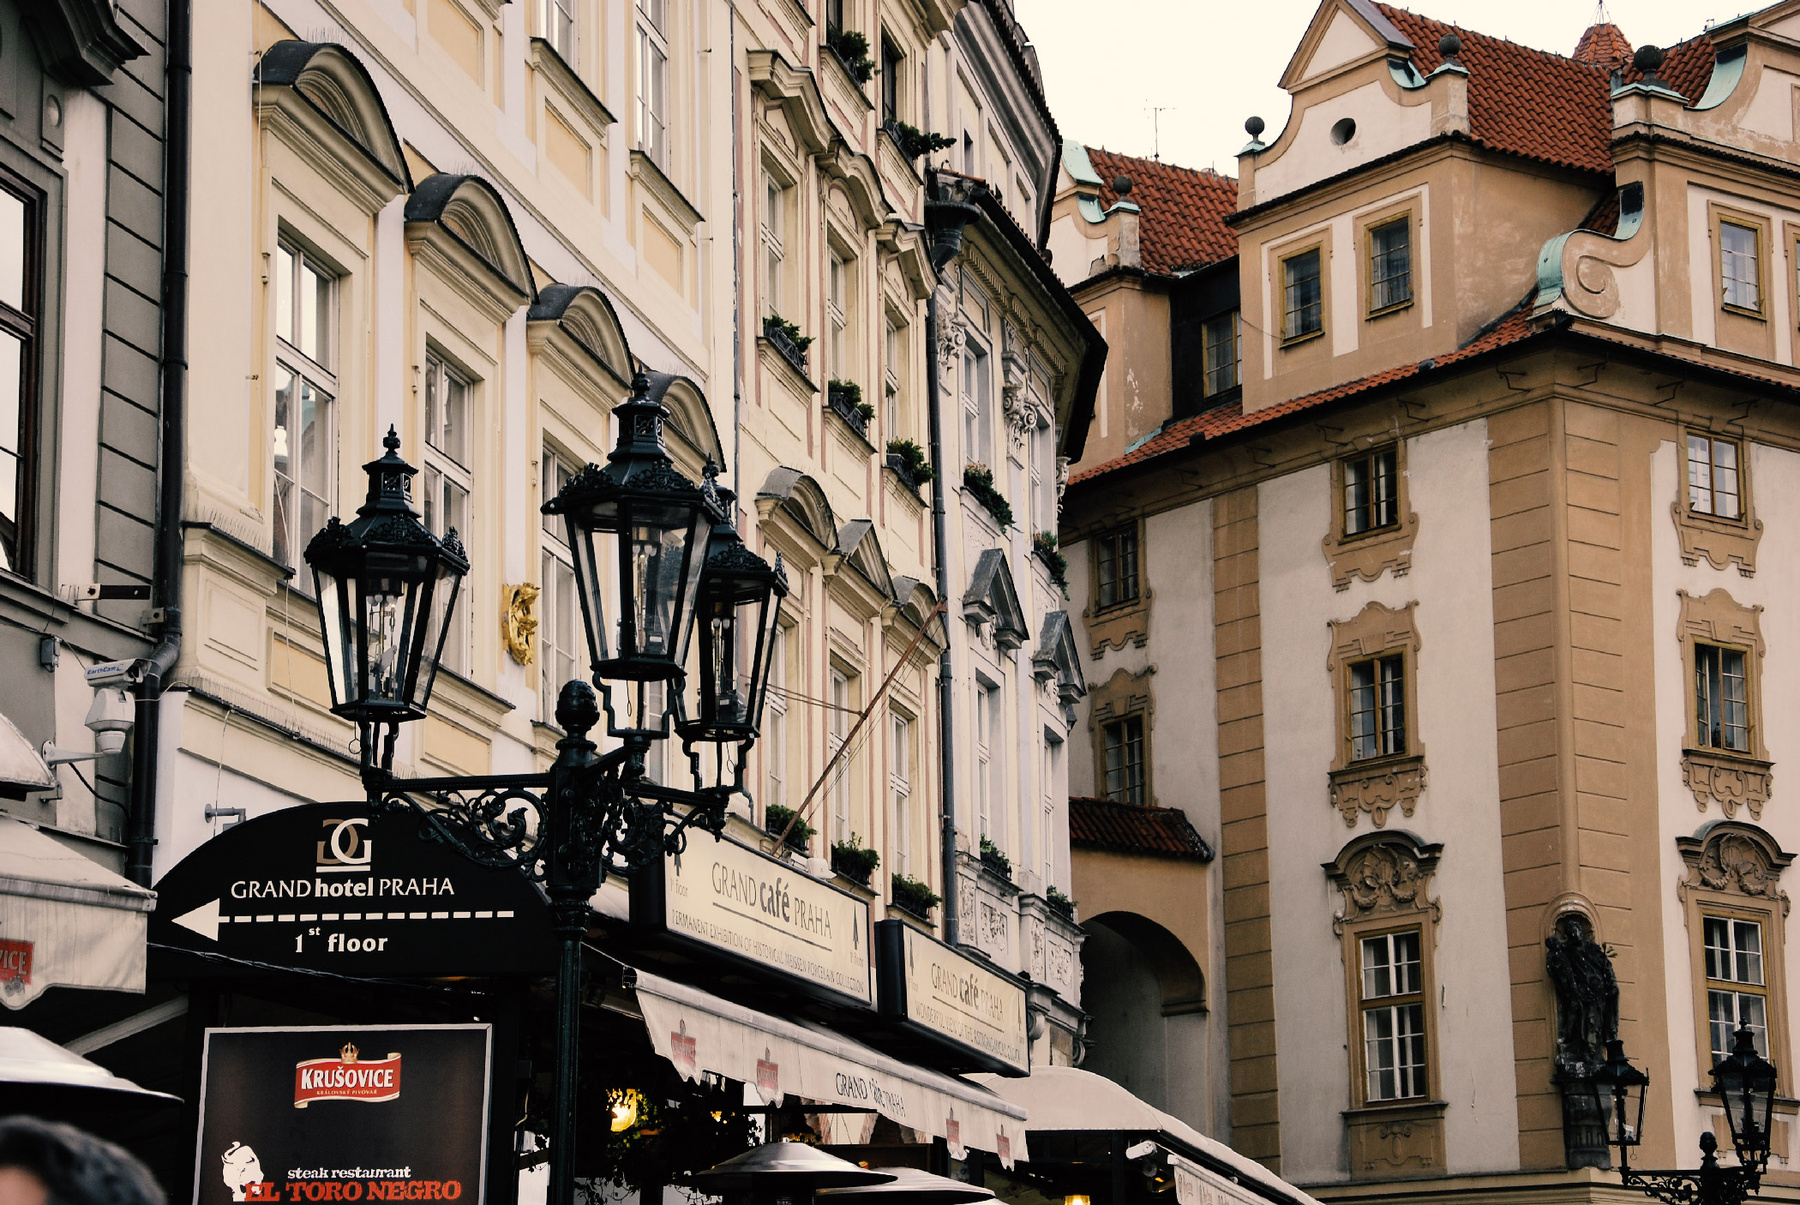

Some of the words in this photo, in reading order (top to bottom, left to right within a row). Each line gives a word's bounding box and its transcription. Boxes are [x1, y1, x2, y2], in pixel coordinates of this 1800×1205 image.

[230, 879, 312, 899] GRAND
[314, 877, 374, 897] hotel
[379, 877, 455, 896] PRAHA
[711, 861, 757, 907] GRAND
[759, 876, 790, 923] café
[794, 897, 832, 939] PRAHA
[327, 933, 388, 952] floor
[931, 962, 958, 999] GRAND
[959, 973, 979, 1010] café
[301, 1066, 394, 1090] KRUŠOVICE
[835, 1072, 868, 1100] GRAND
[287, 1167, 329, 1180] steak
[330, 1166, 412, 1179] restaurant
[244, 1182, 280, 1202] EL
[285, 1181, 363, 1202] TORO
[366, 1180, 462, 1201] NEGRO
